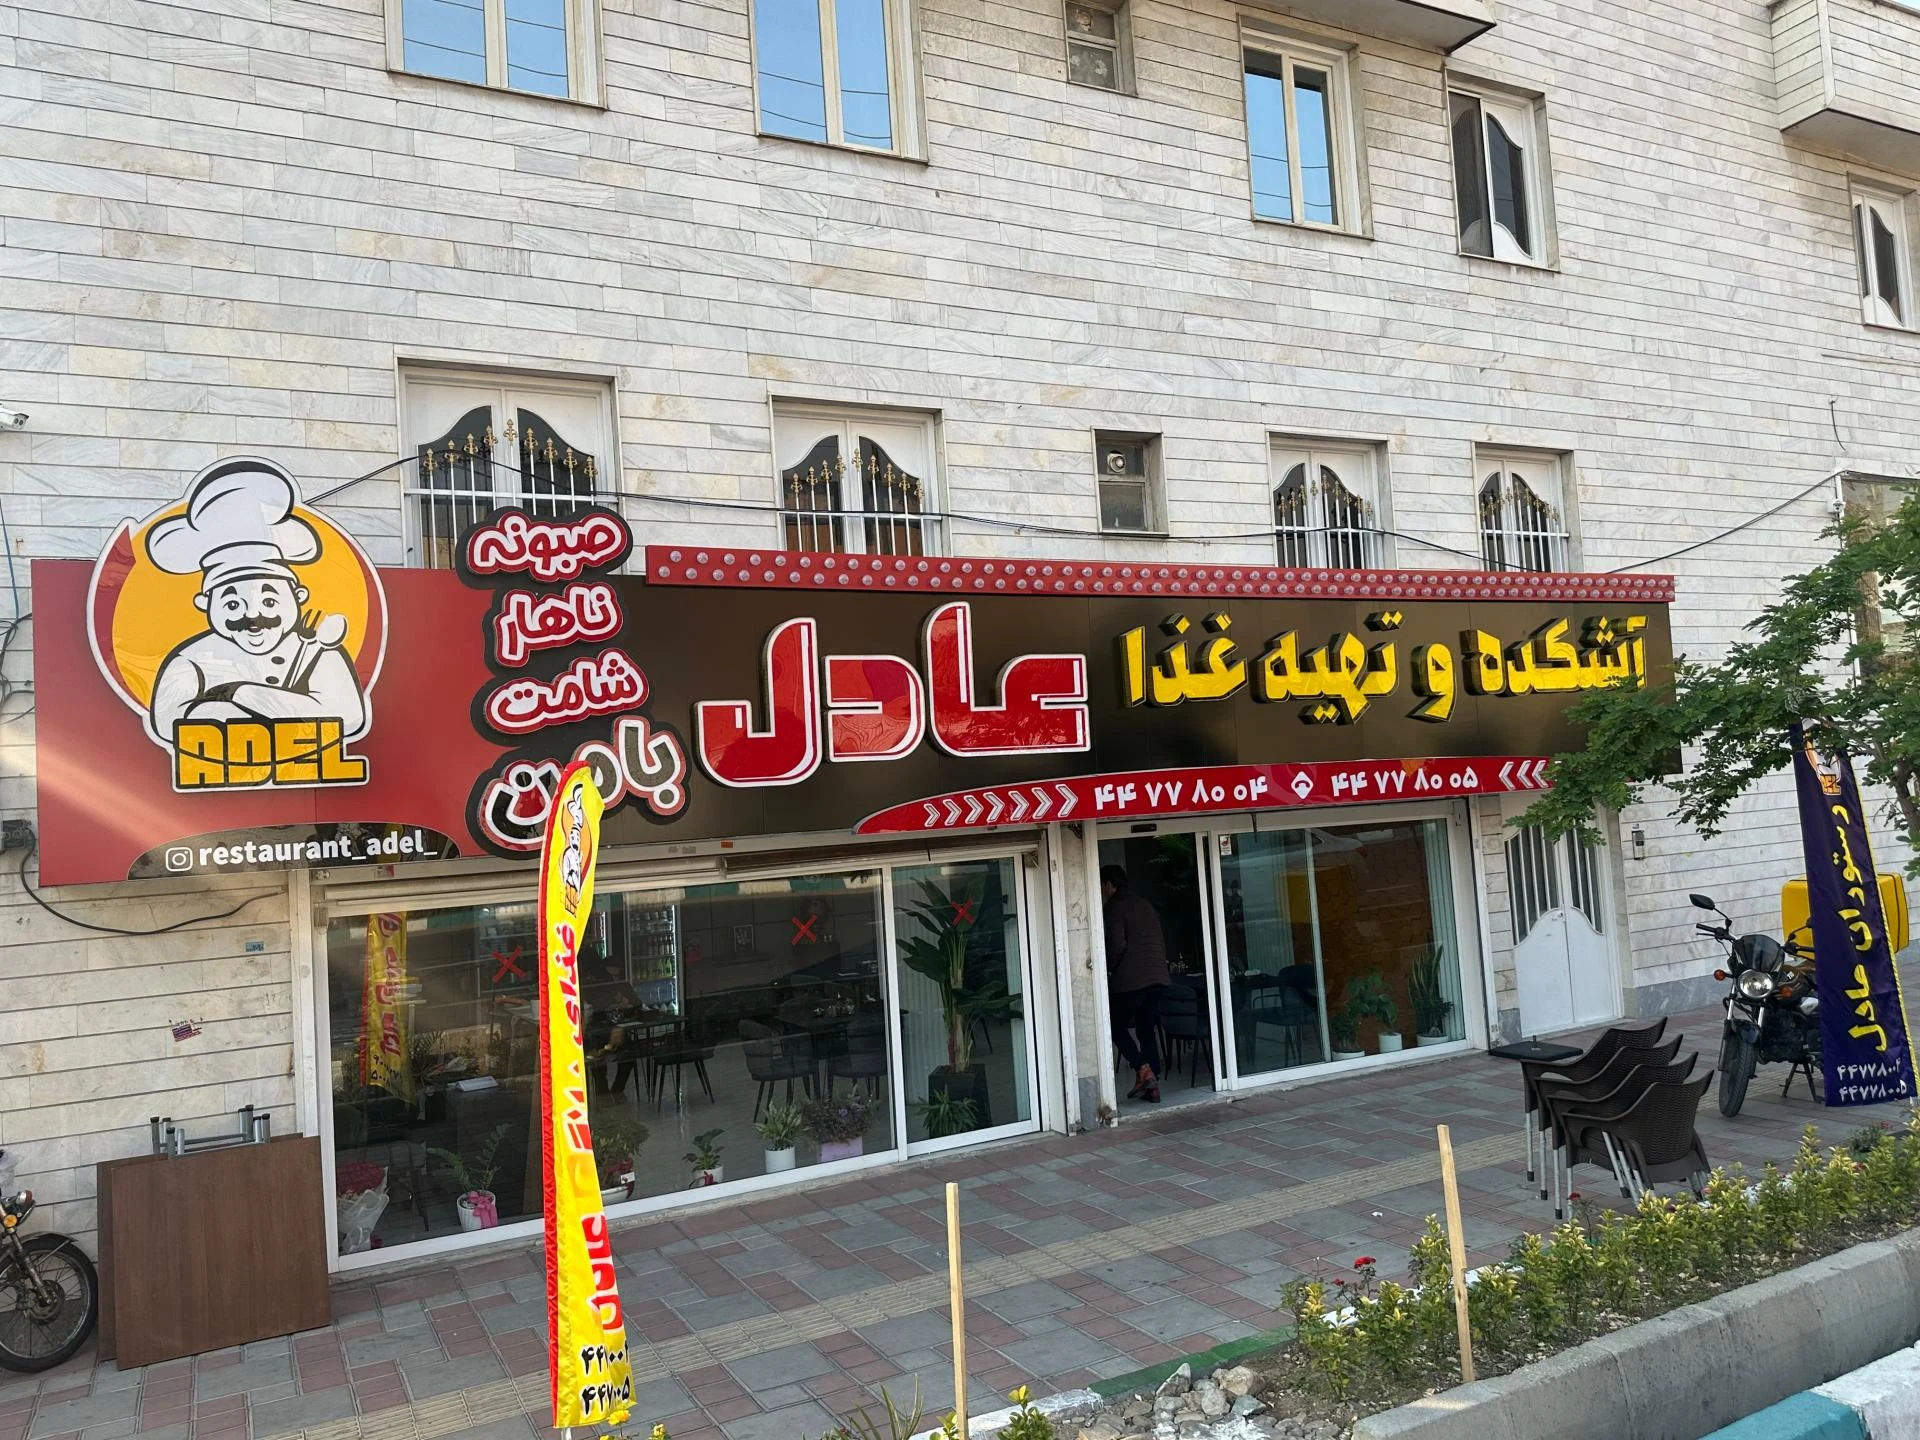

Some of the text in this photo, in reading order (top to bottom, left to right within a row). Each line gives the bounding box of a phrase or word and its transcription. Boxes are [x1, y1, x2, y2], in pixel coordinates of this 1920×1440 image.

[472, 514, 623, 577] صبونه
[499, 585, 619, 662] ناهار
[489, 650, 645, 728] شامت
[697, 602, 1648, 788] آتشکده و تهیه غذا عادل
[174, 718, 368, 790] ADEL
[200, 829, 438, 866] restaurant_adel_
